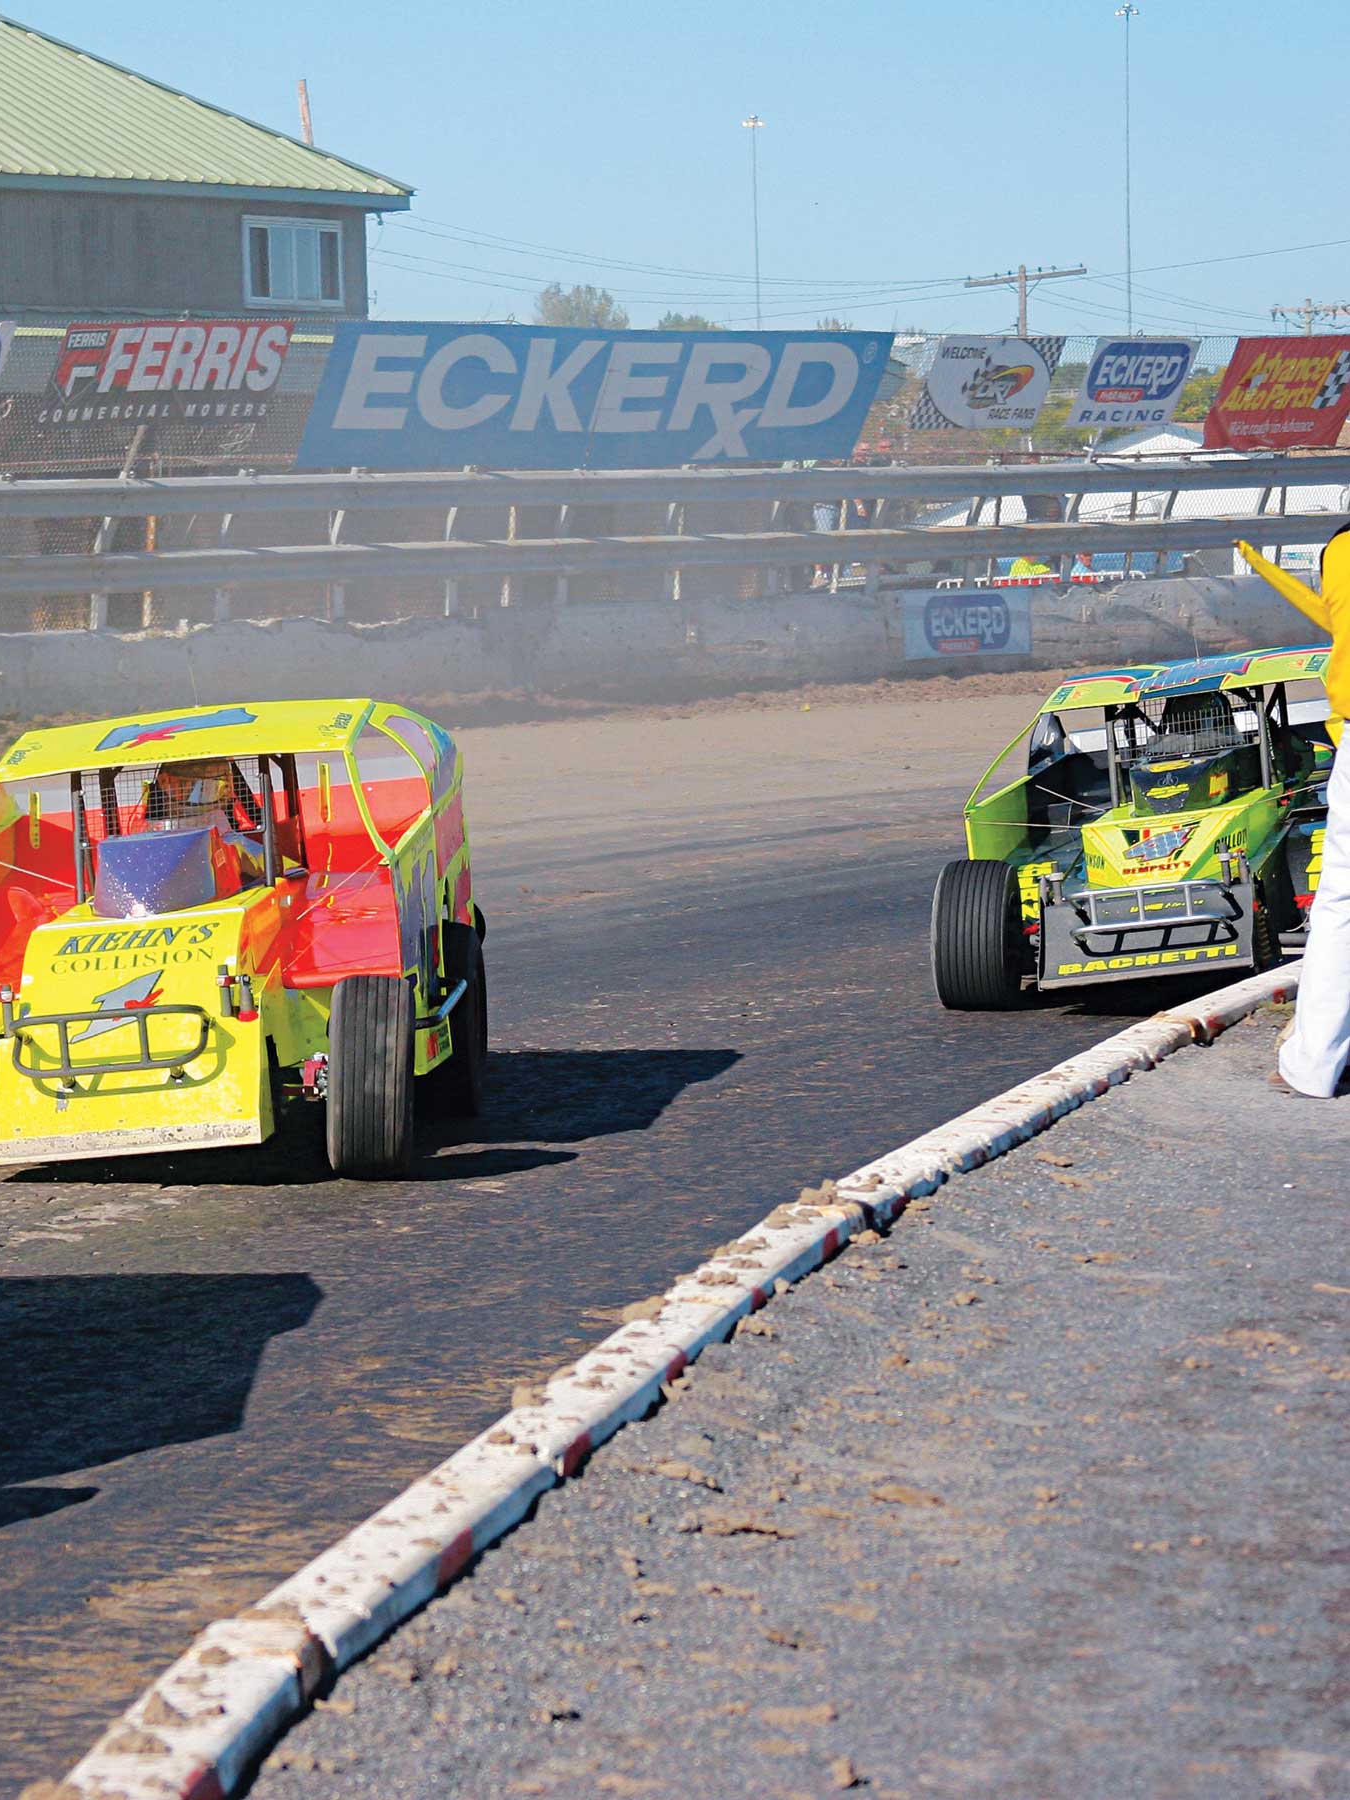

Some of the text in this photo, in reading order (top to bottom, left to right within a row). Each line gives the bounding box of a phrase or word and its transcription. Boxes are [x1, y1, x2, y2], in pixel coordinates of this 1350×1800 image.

[67, 331, 109, 349] FERRIS
[941, 346, 987, 360] WELCOME
[96, 324, 289, 393] FERRIS
[1094, 355, 1182, 396] ECKERD
[332, 334, 860, 460] ECKERD
[38, 403, 269, 424] COMMERCIAL MOWERS
[987, 407, 1036, 420] RACE FANS
[1078, 408, 1165, 423] RACING
[931, 605, 1006, 645] ECKERD
[1121, 860, 1192, 875] DEMPSEY'S
[54, 922, 220, 957] KIEHN'S
[50, 946, 215, 975] COLLISION
[1057, 944, 1238, 976] BACHETTI
